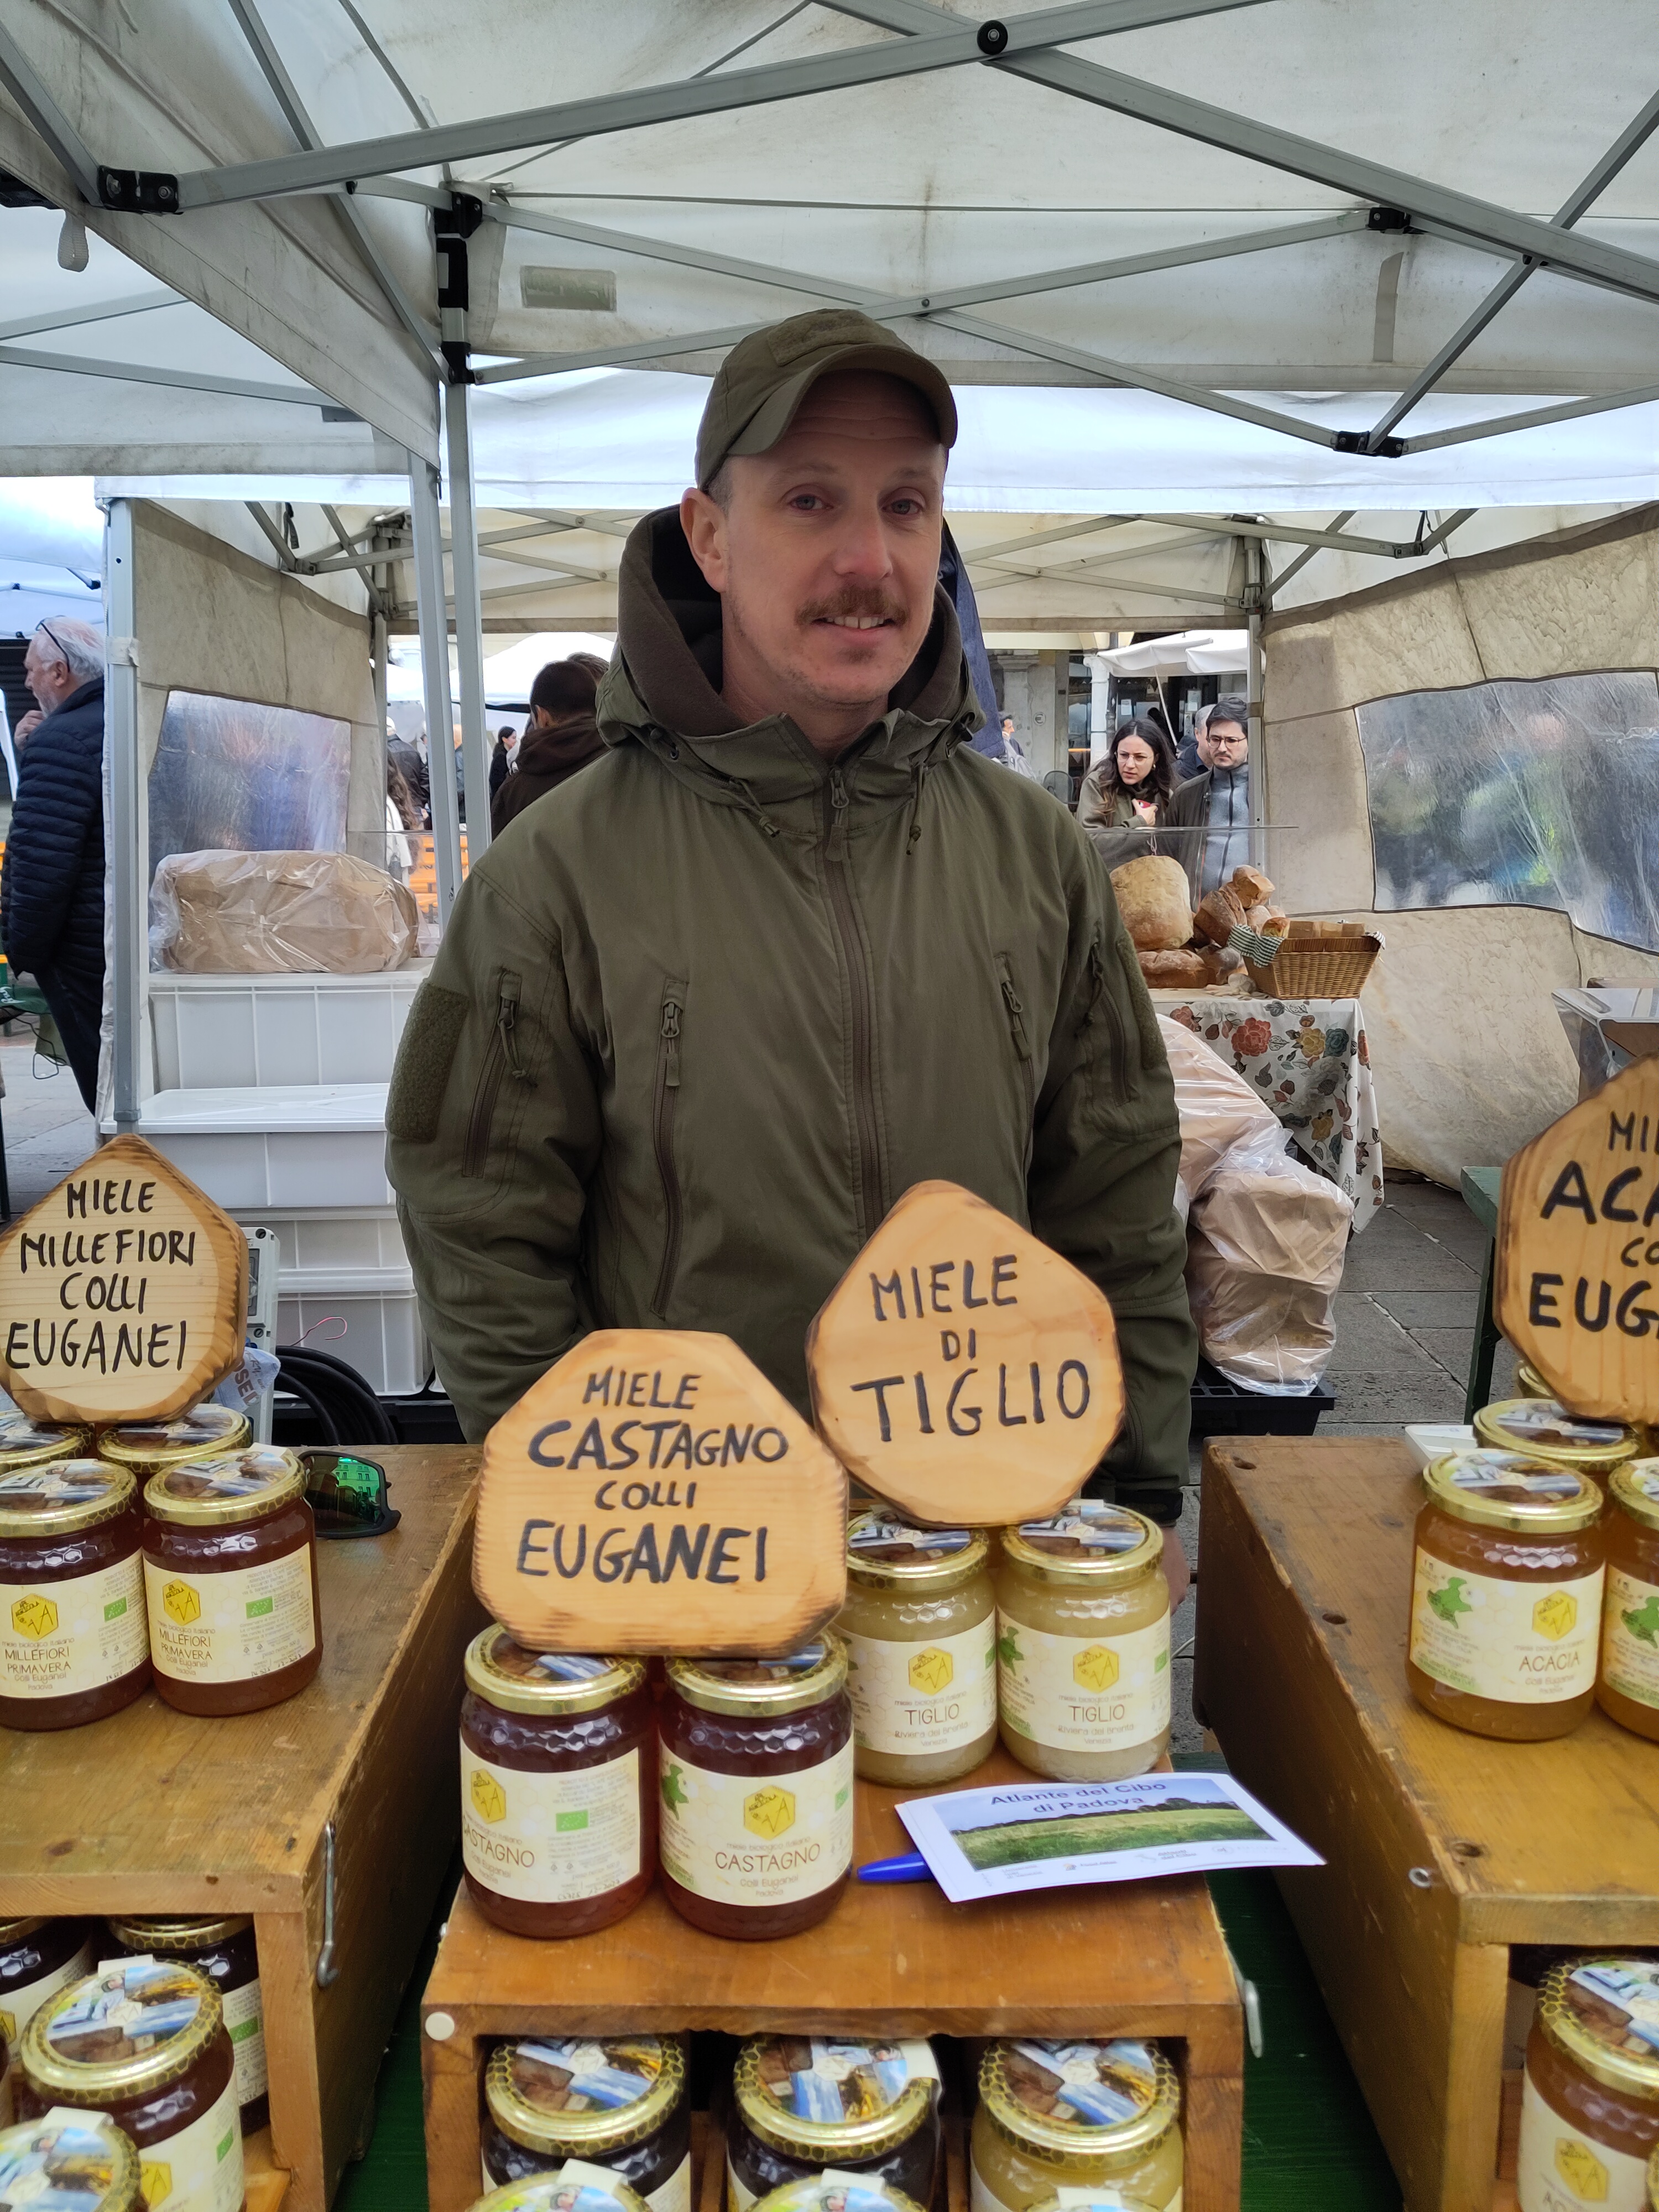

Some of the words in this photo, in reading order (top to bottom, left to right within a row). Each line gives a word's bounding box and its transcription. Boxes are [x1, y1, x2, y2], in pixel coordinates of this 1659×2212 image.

[1608, 1111, 1659, 1155] MI
[67, 1179, 156, 1219] MIELE
[20, 1229, 195, 1274] MILLEFIORI
[59, 1272, 147, 1314] COLLI
[869, 1254, 1018, 1322] MIELE
[1528, 1273, 1659, 1339] EUG
[5, 1318, 187, 1375] EUGANEI
[940, 1328, 976, 1361] DI
[582, 1366, 702, 1410] MIELE
[849, 1359, 1091, 1442] TIGLIO
[528, 1417, 789, 1470] CASTAGNO
[594, 1481, 696, 1511] COLLI
[516, 1519, 768, 1584] EUGANEI
[5, 1646, 70, 1661] MILLEFIORI
[159, 1627, 211, 1647] MILLEFIORI
[161, 1642, 212, 1660] PRIMAVERA
[7, 1661, 71, 1674] PRIMAVERA
[1519, 1651, 1580, 1672] ACACIA
[904, 1703, 959, 1725] TIGLIO
[1068, 1704, 1125, 1723] TIGLIO
[990, 1791, 1069, 1806] Atlante
[1076, 1787, 1108, 1798] del
[1115, 1782, 1167, 1793] Cibo
[1033, 1802, 1055, 1813] di
[1060, 1797, 1145, 1811] Padova
[463, 1814, 535, 1867] CASTAGNO
[715, 1843, 821, 1872] CASTAGNO
